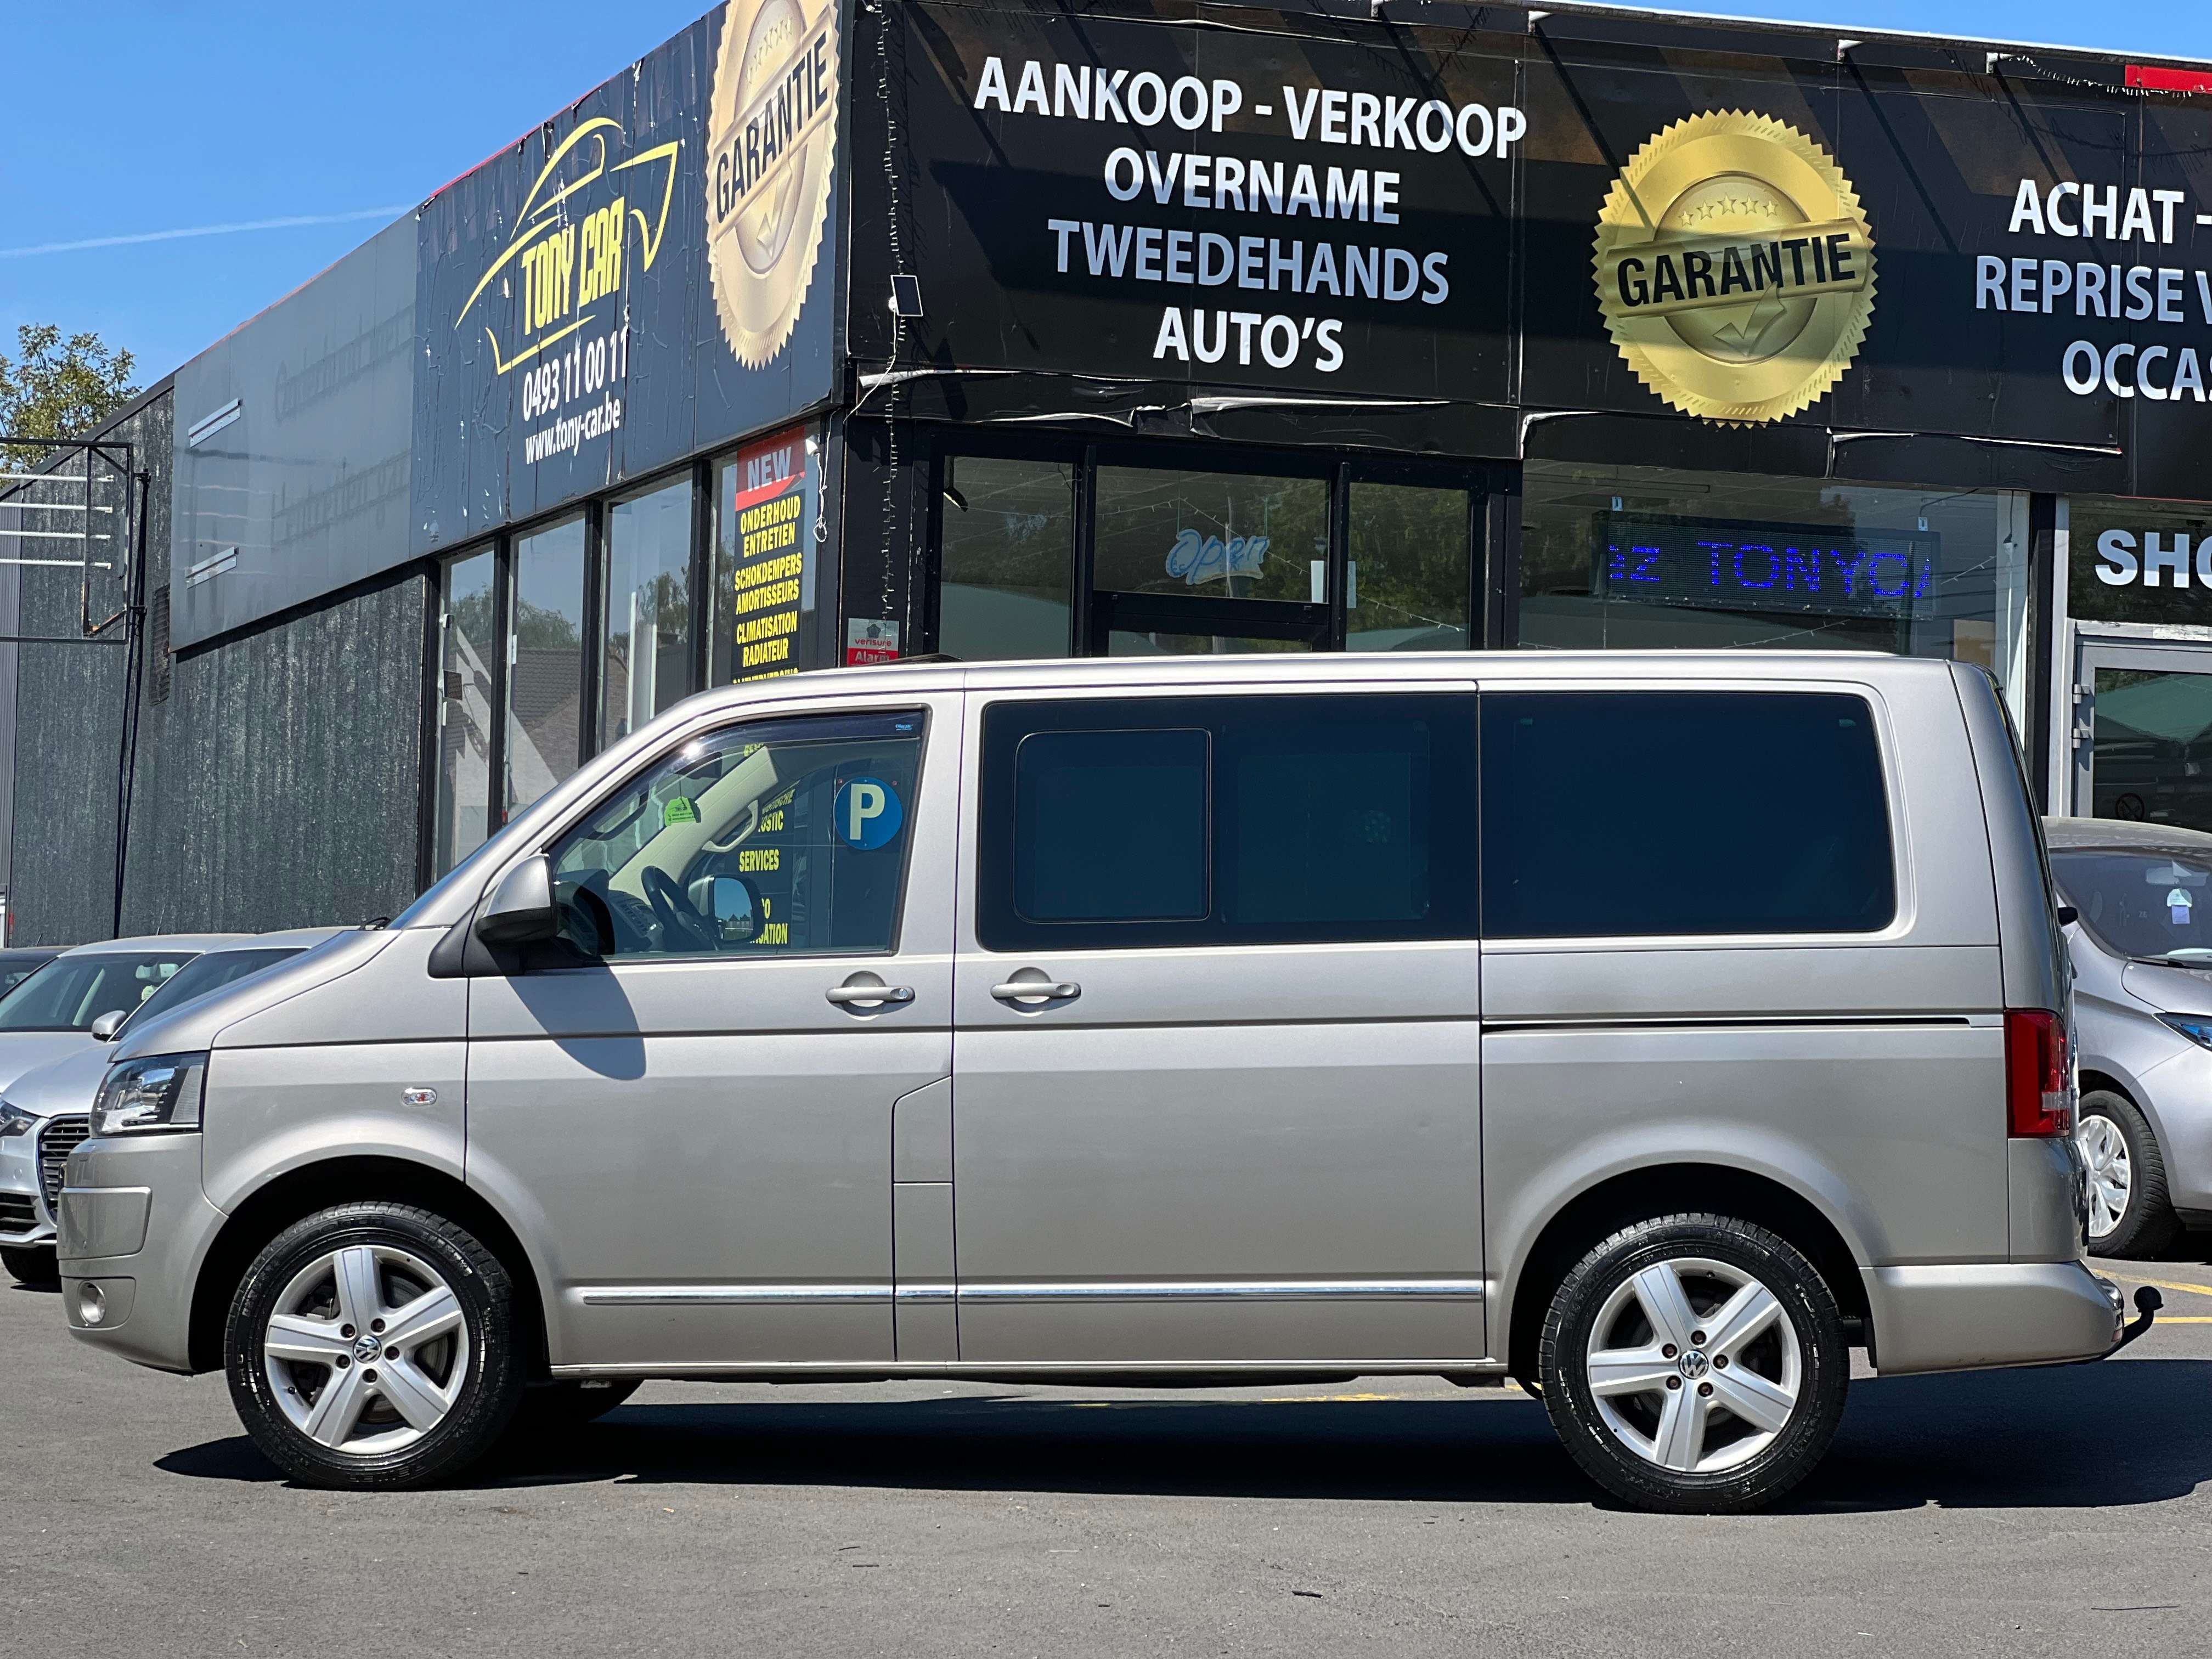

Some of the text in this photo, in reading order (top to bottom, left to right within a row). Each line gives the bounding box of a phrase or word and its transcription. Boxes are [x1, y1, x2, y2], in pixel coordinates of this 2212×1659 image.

[716, 30, 828, 224] GARANTIE
[974, 57, 1242, 132] AANKOOP
[1283, 86, 1526, 159] VERKOOP
[1103, 147, 1400, 224] OVERNAME
[2008, 179, 2184, 244] ACHAT
[522, 196, 624, 335] TONY CAR
[1048, 218, 1449, 304] TWEEDEHANDS
[1617, 233, 1855, 307] GARANTIE
[1976, 255, 2184, 323] REPRISE
[1153, 306, 1344, 372] AUTO'S
[523, 326, 628, 421] 0493 11 00 11
[2062, 340, 2212, 402] OCCA
[526, 391, 620, 465] www.tony-car.be
[748, 447, 791, 492] NEW
[741, 496, 800, 534] ONDERHOUD
[743, 522, 795, 558] ENTRETIEN
[735, 552, 802, 591] SCHOKDEMPERS
[1167, 530, 1269, 584] Open
[736, 579, 799, 615] AMORTISSEURS
[737, 611, 798, 644] CLIMATISATION
[743, 637, 789, 668] RADIATEUR
[854, 638, 892, 647] verisure
[855, 651, 890, 663] Alarm
[850, 783, 885, 840] P
[739, 849, 780, 872] SERVICES
